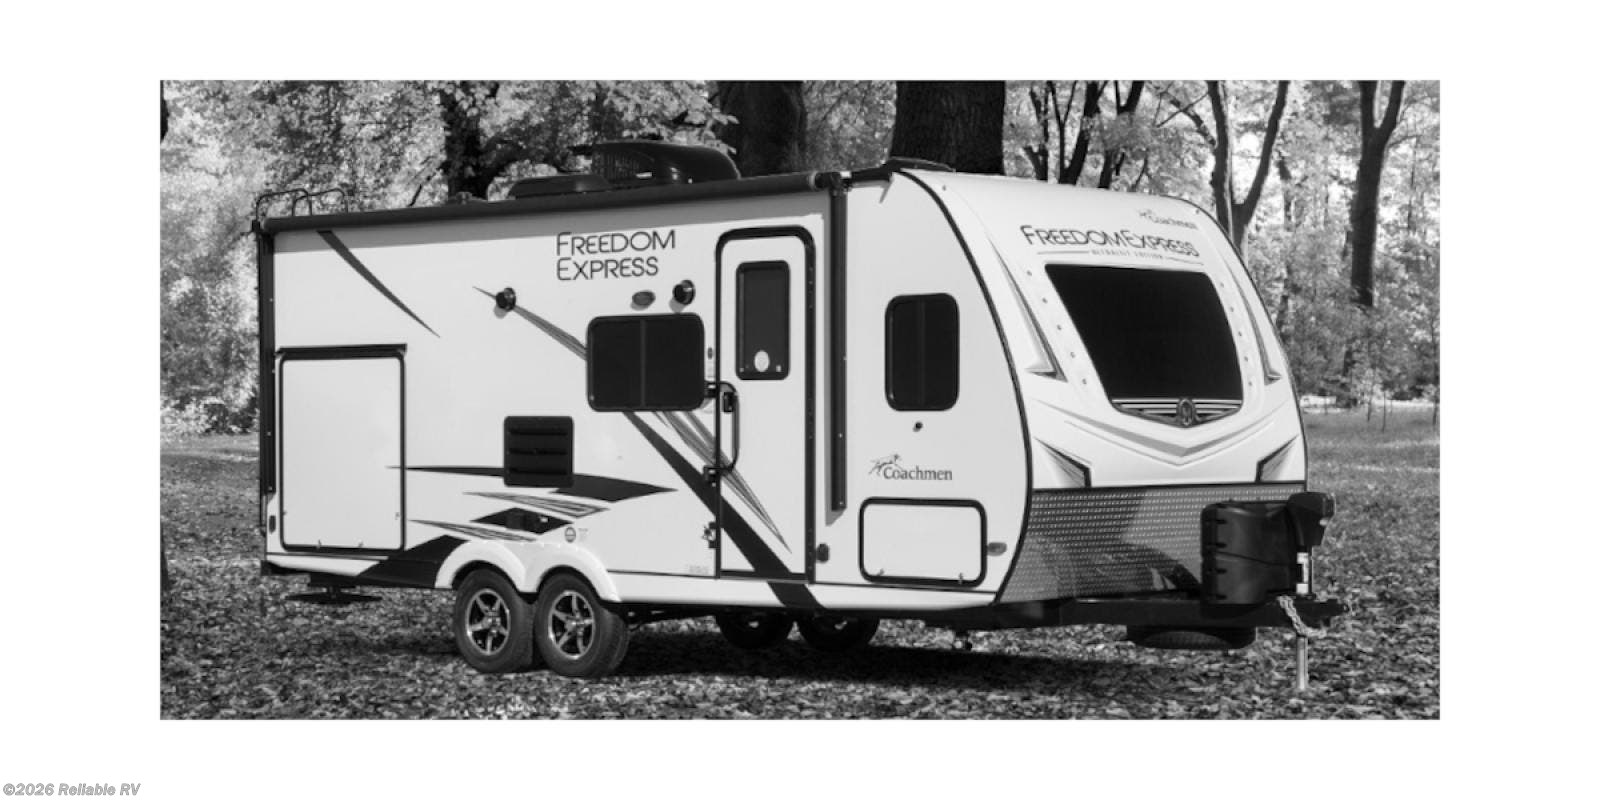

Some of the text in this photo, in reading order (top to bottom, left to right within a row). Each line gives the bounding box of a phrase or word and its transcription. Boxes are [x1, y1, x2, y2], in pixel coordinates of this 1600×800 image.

[557, 229, 676, 256] FREEDOM
[557, 256, 659, 281] EXPRESS
[883, 464, 953, 481] Coachmen
